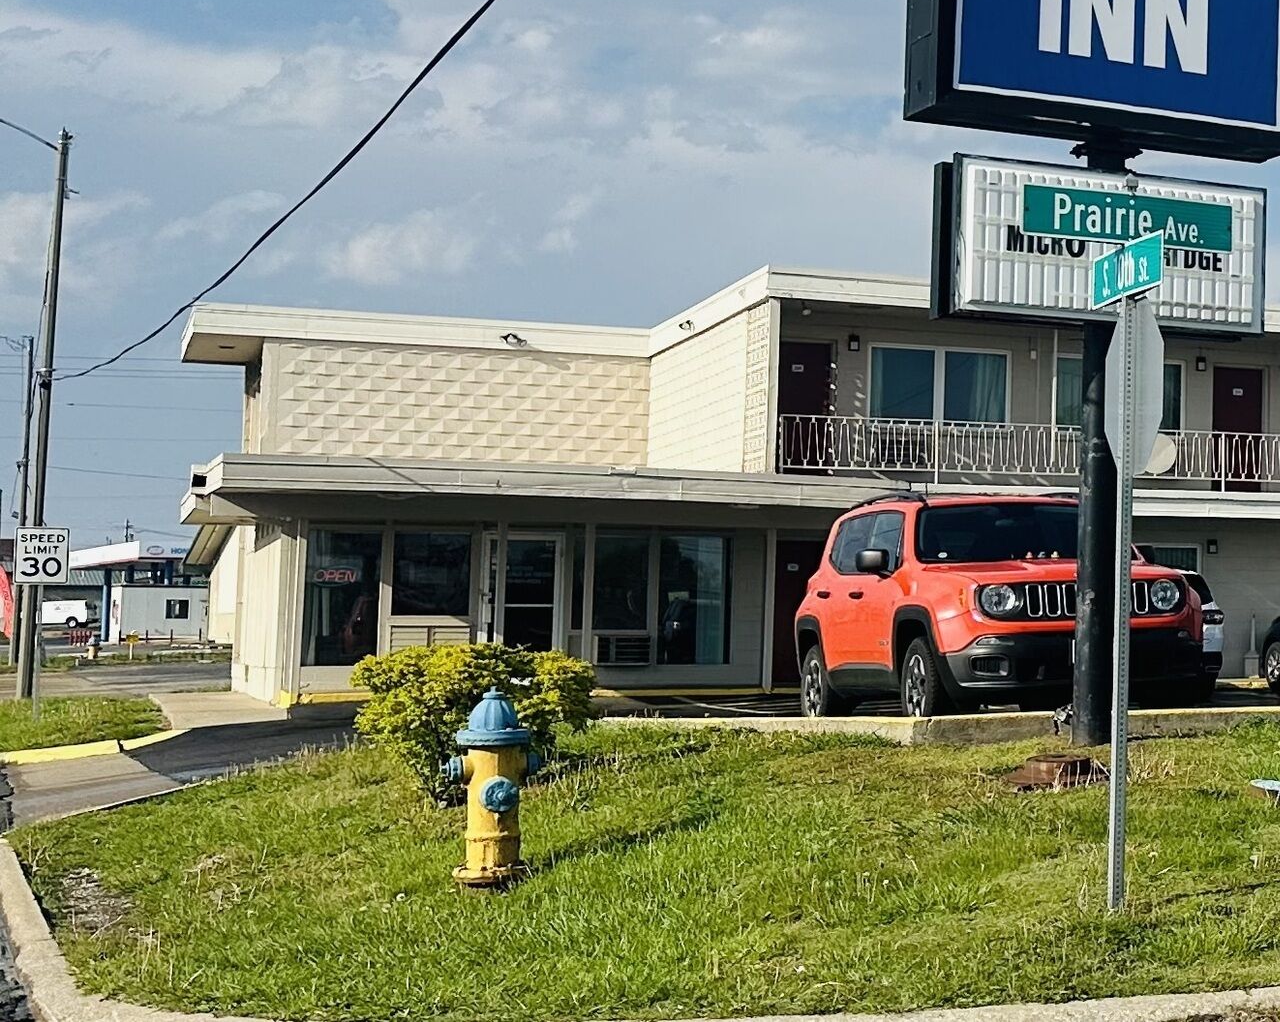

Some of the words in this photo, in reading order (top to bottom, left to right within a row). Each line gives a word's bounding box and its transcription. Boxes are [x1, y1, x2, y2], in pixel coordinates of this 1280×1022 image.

[1053, 192, 1153, 236] Prairie
[1164, 215, 1205, 245] Ave.
[1006, 224, 1086, 258] MICRO
[1102, 260, 1111, 298] S.
[1113, 249, 1135, 290] 10th
[20, 533, 66, 543] SPEED
[24, 545, 60, 555] LIMIT
[20, 556, 62, 577] 30
[314, 569, 357, 583] OPEN
